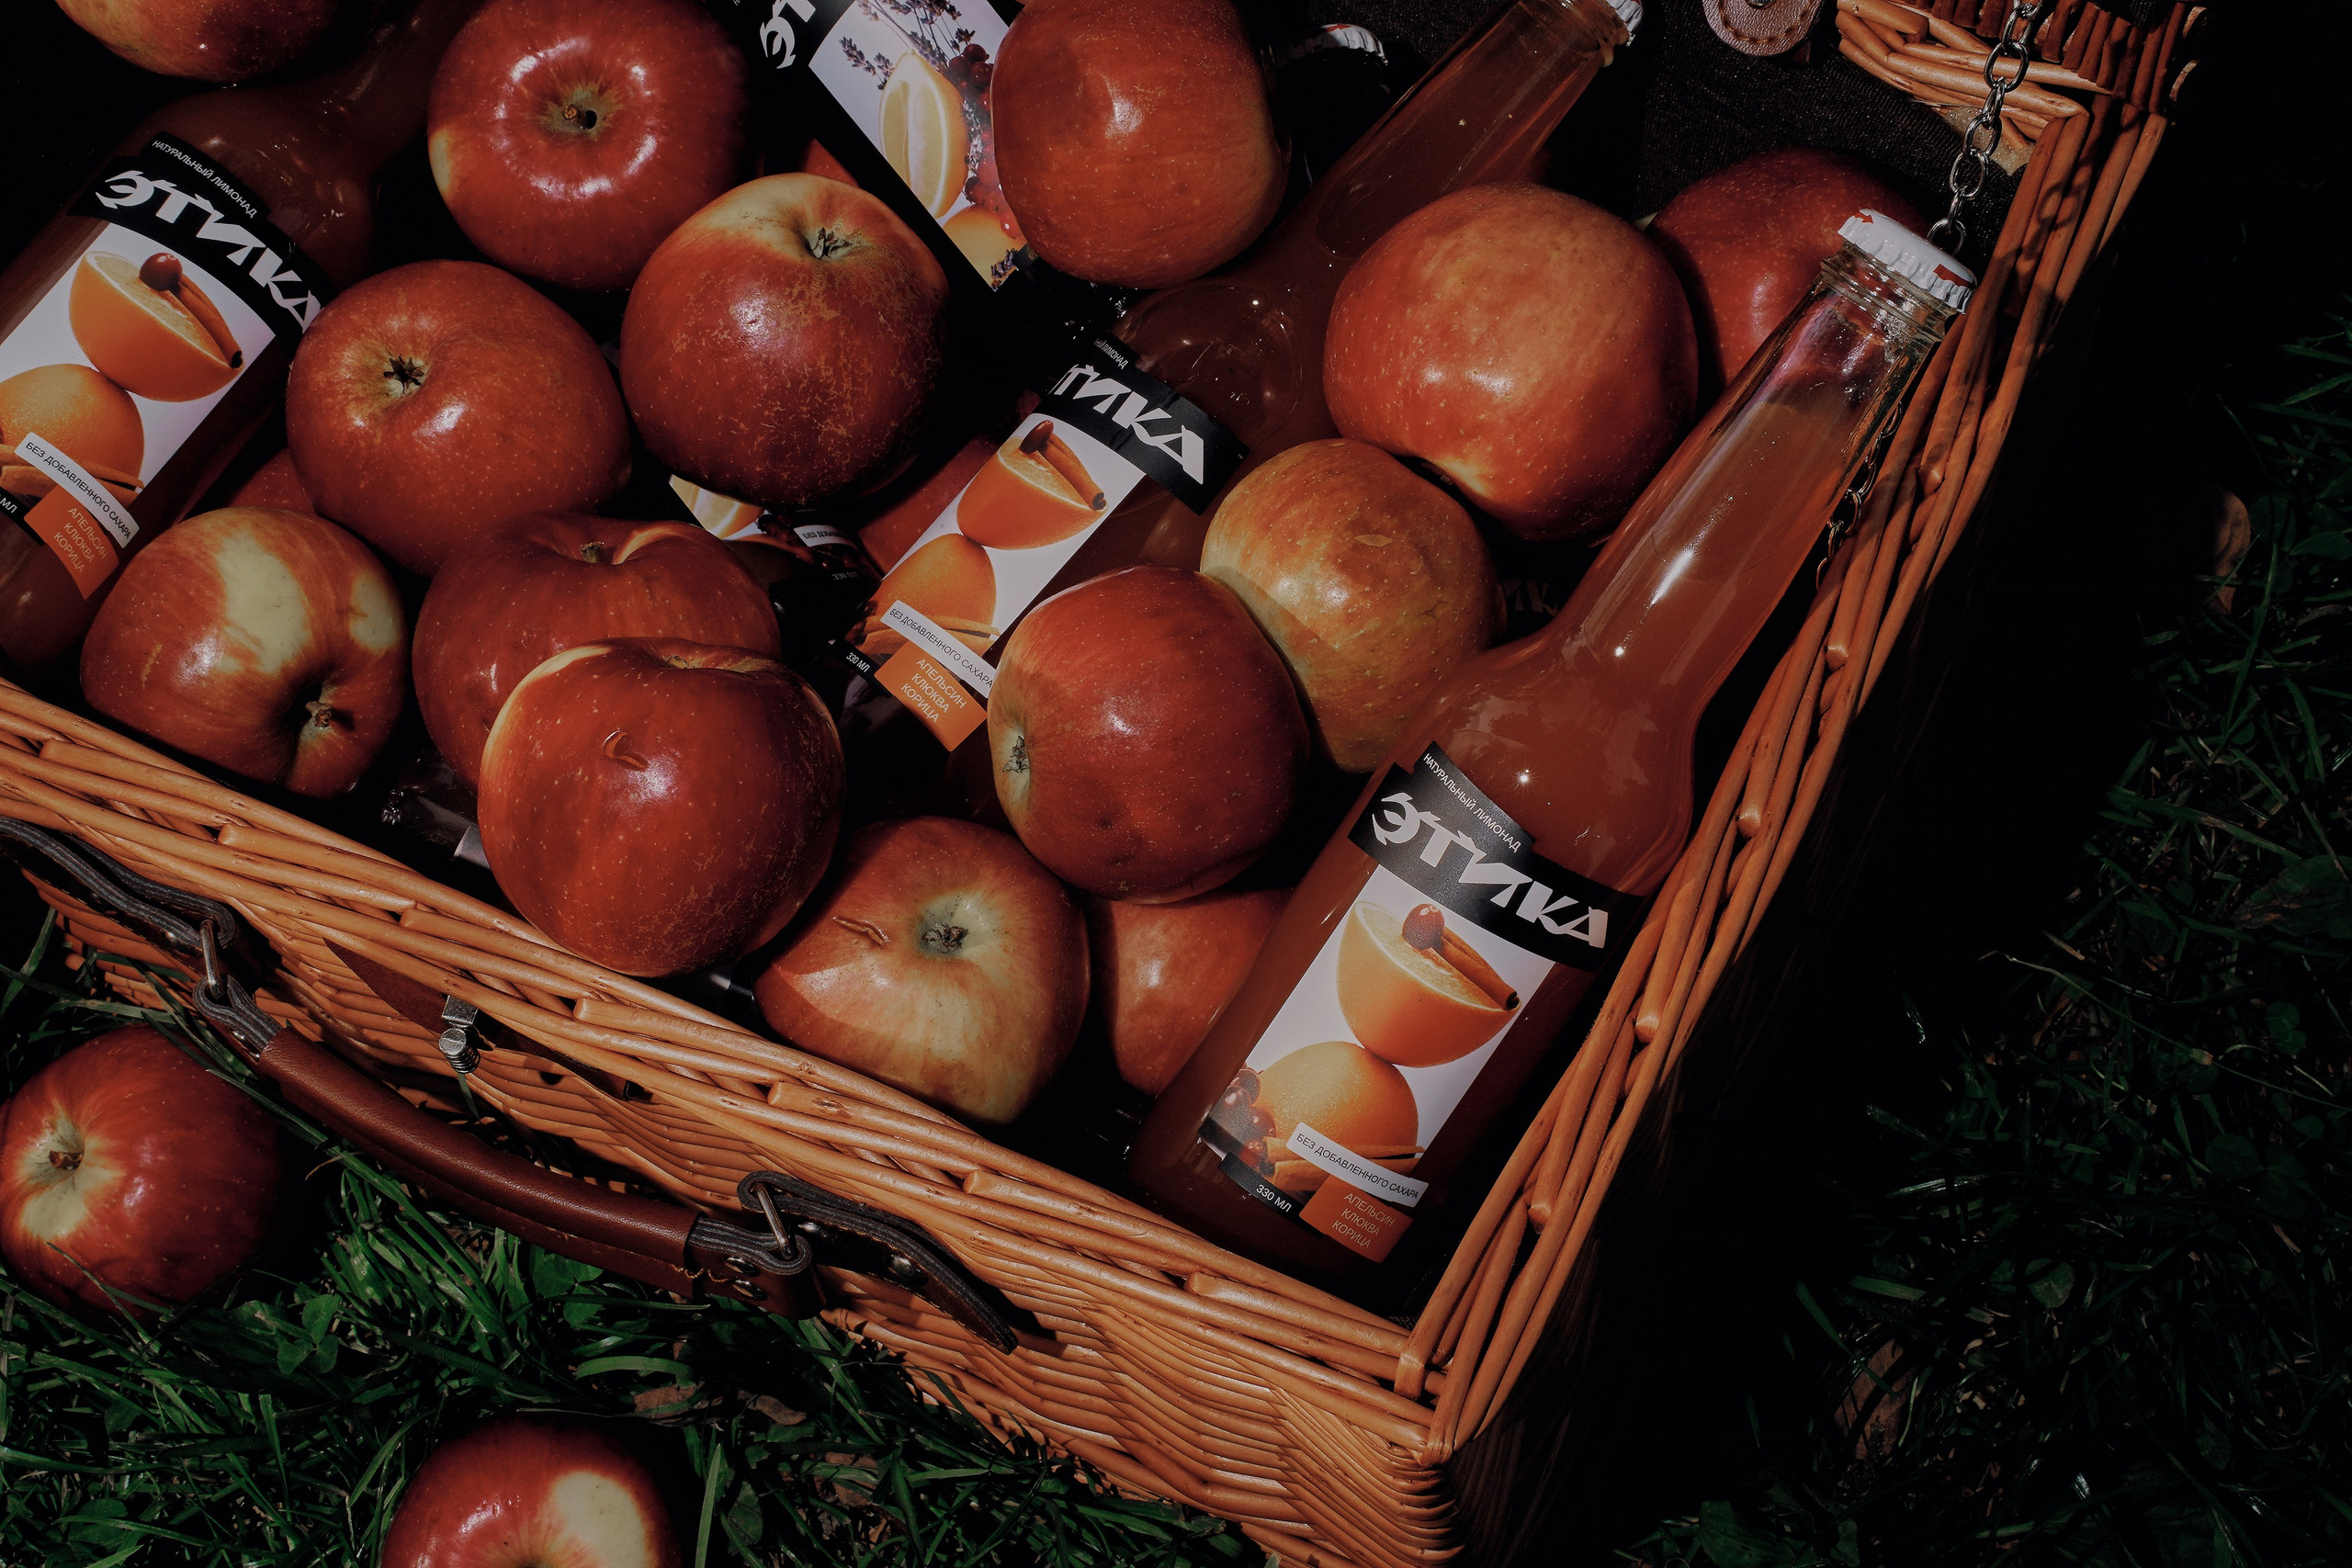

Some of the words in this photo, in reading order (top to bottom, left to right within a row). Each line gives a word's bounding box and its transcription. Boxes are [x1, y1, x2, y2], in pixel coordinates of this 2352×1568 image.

[152, 140, 214, 181] НАТУРАЛЬНЫЙ
[211, 175, 257, 219] ЛИМОНАД
[95, 170, 322, 335] ЭТИКА
[26, 442, 46, 458] БЕЗ
[43, 456, 110, 513] ДОБАВЛЕННОГО
[108, 511, 131, 539] САХАРА
[53, 532, 85, 573] КОРИЦА
[63, 523, 95, 563] КЛЮКВА
[68, 507, 107, 558] АПЕЛЬСИН
[845, 651, 858, 666] 330
[856, 661, 870, 672] МЛ
[889, 608, 902, 620] БЕЗ
[900, 615, 961, 661] ДОБАВЛЕННОГО
[961, 660, 993, 688] САХАРА
[900, 683, 939, 723] КОРИЦА
[911, 673, 950, 713] КЛЮКВА
[916, 659, 967, 708] АПЕЛЬСИН
[1423, 753, 1476, 810] НАТУРАЛЬНЫЙ
[1473, 807, 1521, 852] ЛИМОНАД
[1372, 792, 1608, 949] ЭТИКА
[1296, 1133, 1316, 1149] БЕЗ
[1315, 1145, 1389, 1189] ДОБАВЛЕННОГО
[1388, 1183, 1419, 1200] САХАРА
[1256, 1184, 1274, 1201] 330
[1273, 1197, 1292, 1213] МЛ
[1343, 1192, 1396, 1227] АПЕЛЬСИН
[1331, 1220, 1372, 1249] КОРИЦА
[1341, 1208, 1380, 1236] КЛЮКВА
